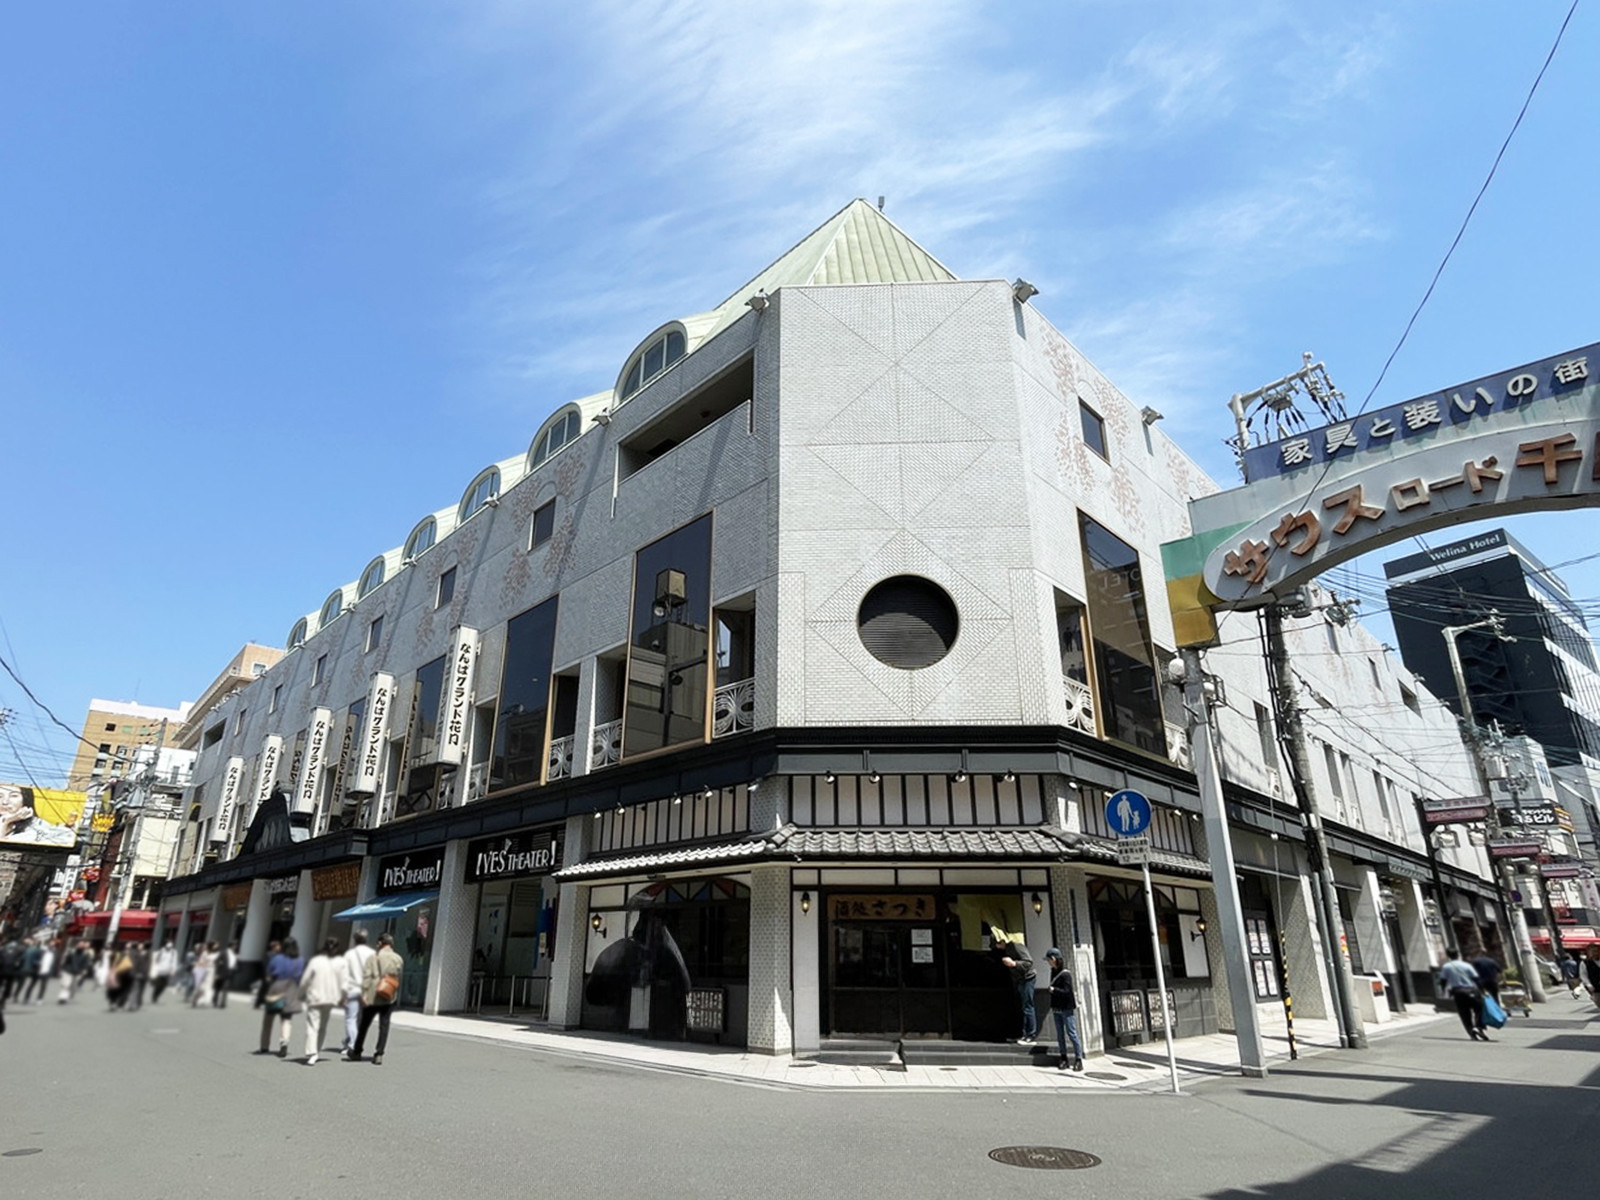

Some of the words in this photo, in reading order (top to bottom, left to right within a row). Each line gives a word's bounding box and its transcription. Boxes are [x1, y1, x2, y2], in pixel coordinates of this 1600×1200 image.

[1280, 356, 1589, 466] 家具と装いの街
[1223, 431, 1600, 586] サウスロード千
[1429, 547, 1467, 561] Welina
[1469, 534, 1501, 551] Hotel
